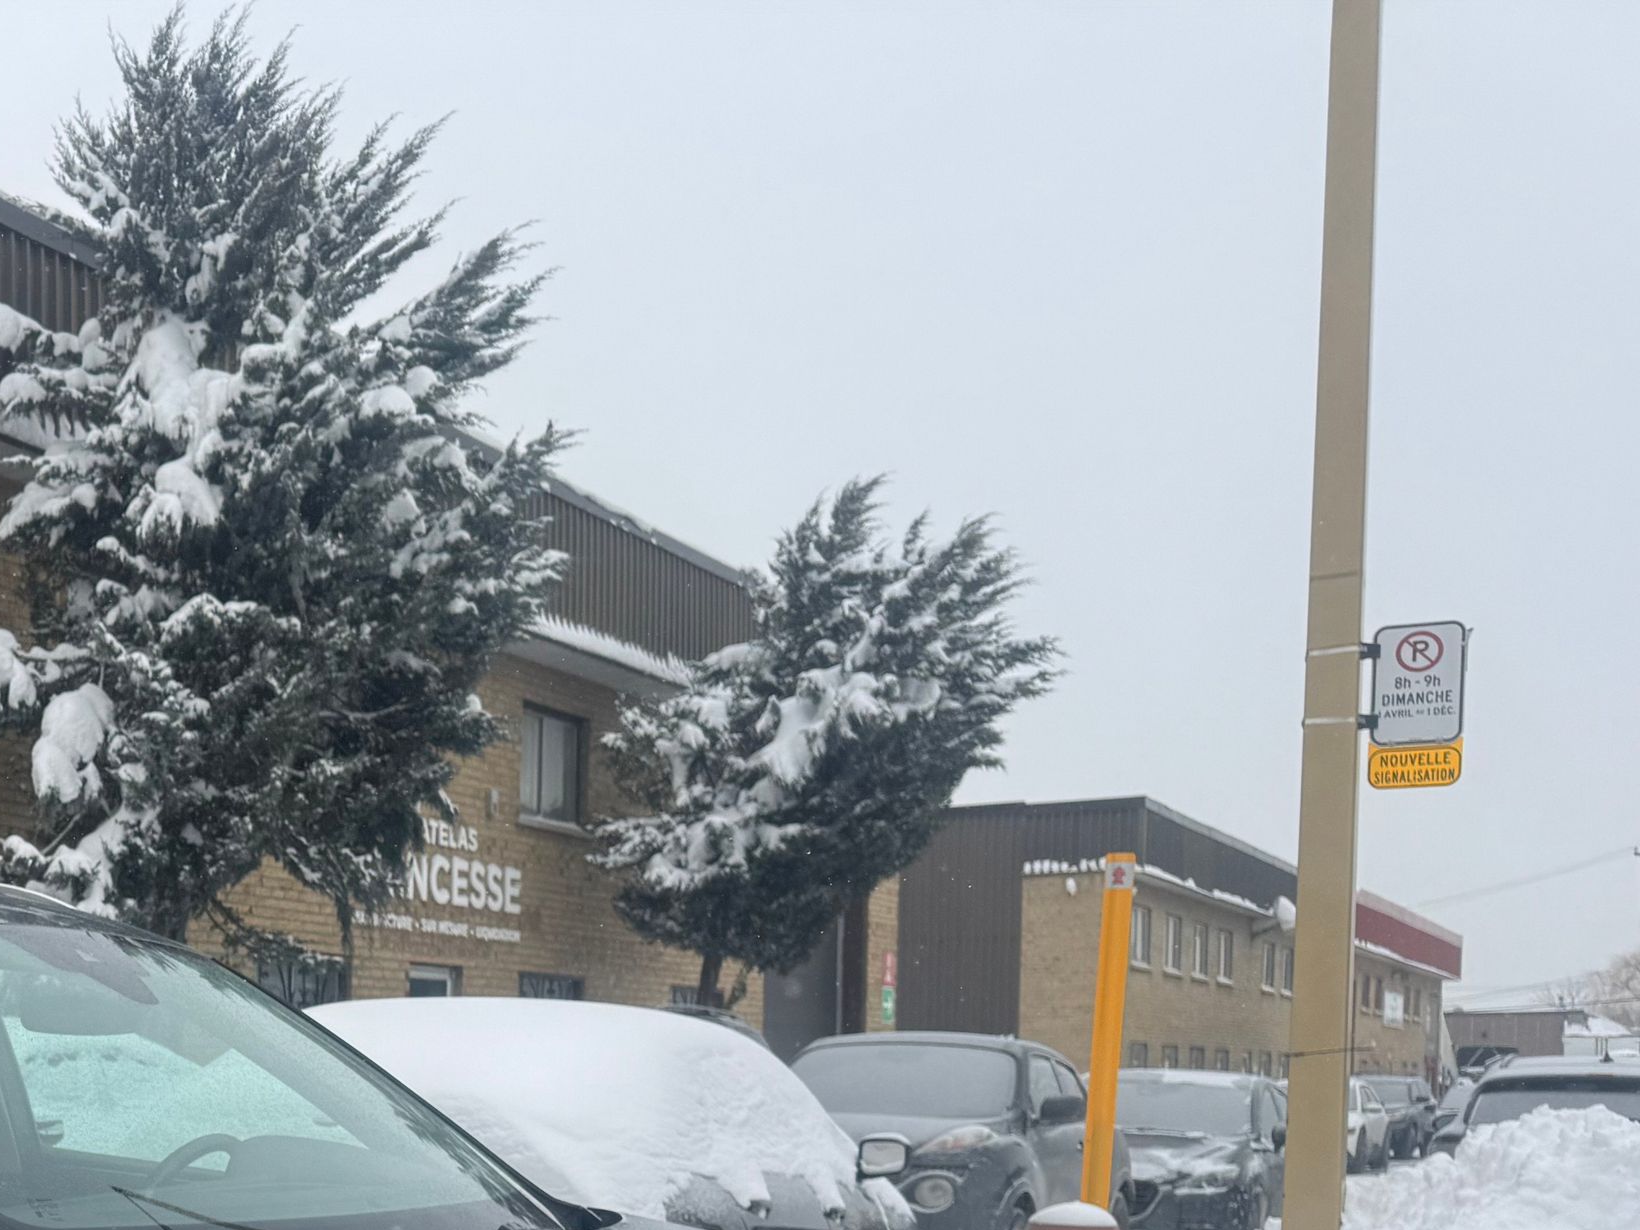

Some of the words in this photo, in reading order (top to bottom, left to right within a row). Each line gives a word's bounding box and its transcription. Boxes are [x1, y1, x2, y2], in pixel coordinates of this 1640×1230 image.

[1395, 676, 1411, 690] 8h
[1424, 674, 1441, 688] 9h
[1382, 689, 1453, 707] DIMANCHE
[1384, 708, 1413, 719] AVRIL
[1380, 751, 1452, 768] NOUVELLE
[1374, 767, 1455, 785] SIGNALISATION
